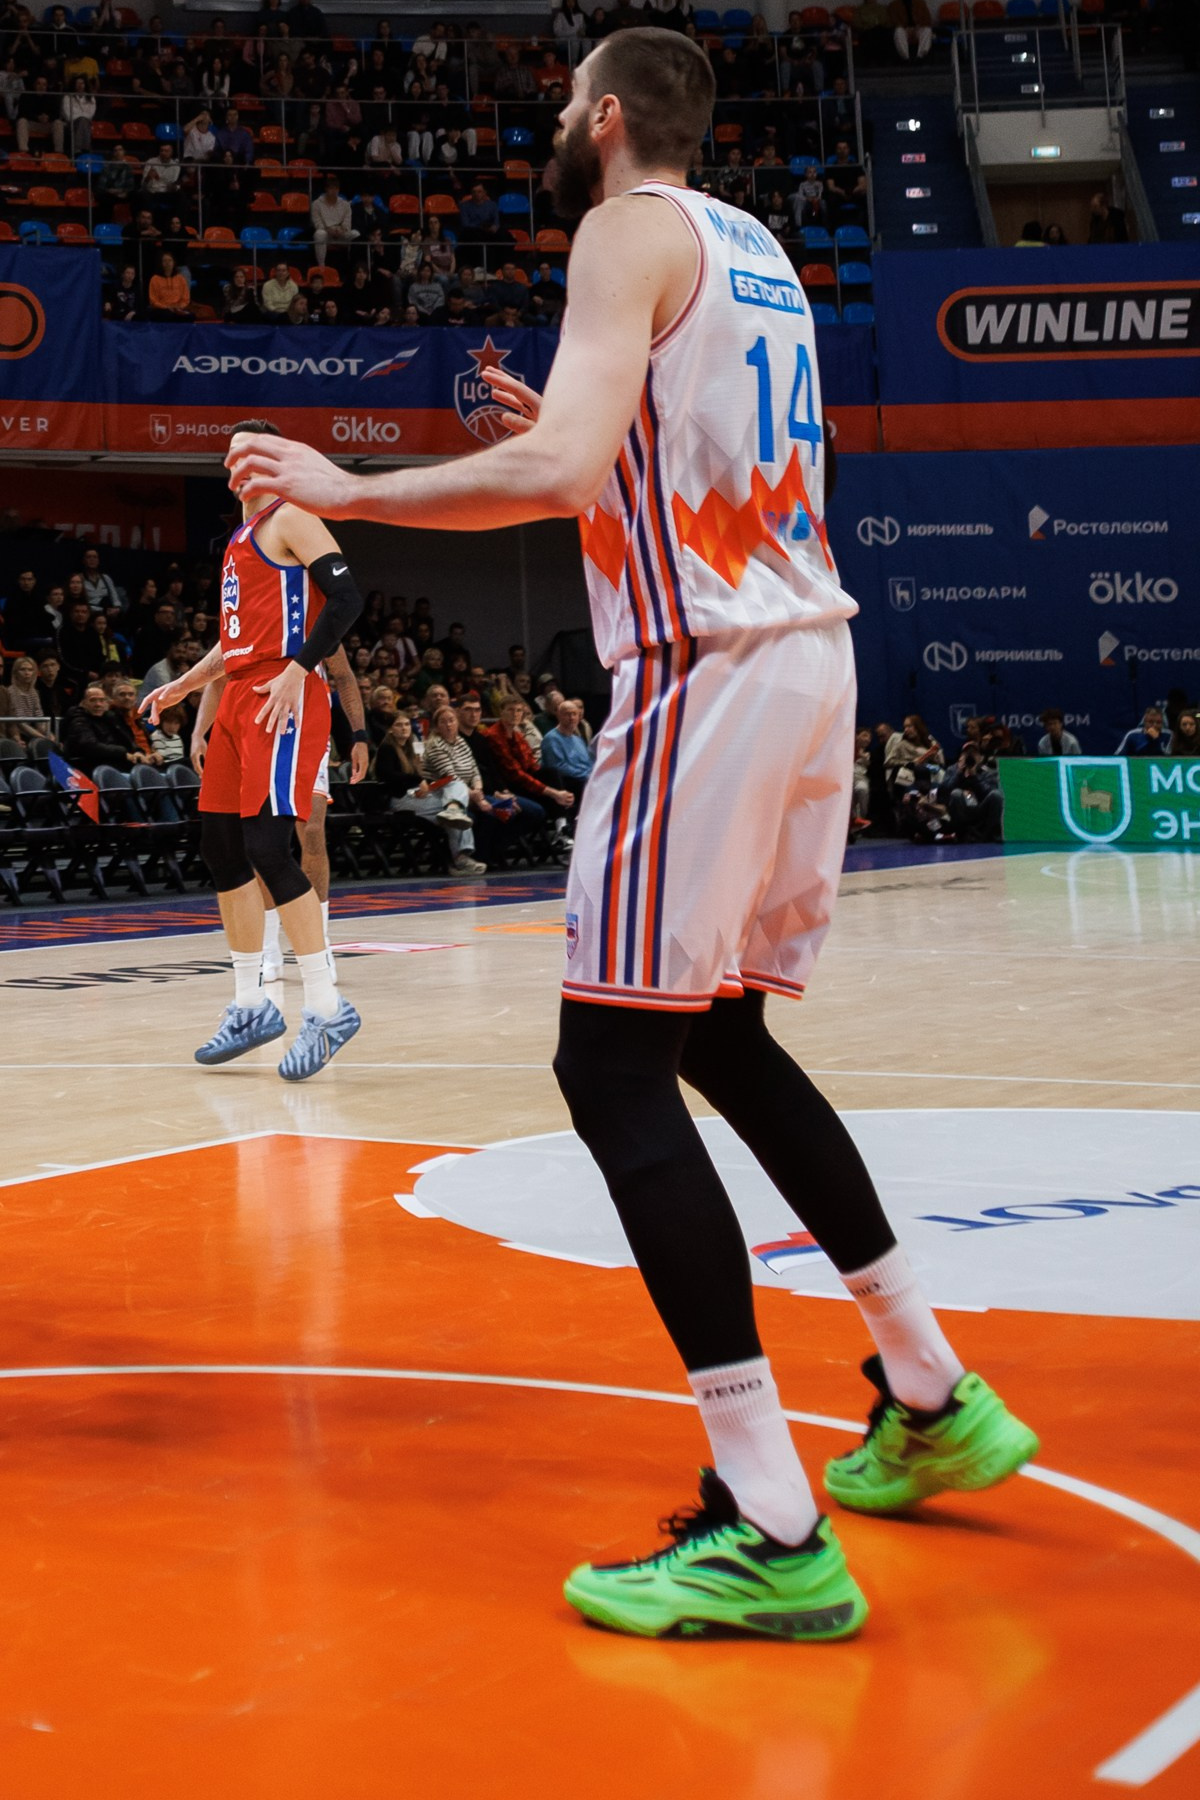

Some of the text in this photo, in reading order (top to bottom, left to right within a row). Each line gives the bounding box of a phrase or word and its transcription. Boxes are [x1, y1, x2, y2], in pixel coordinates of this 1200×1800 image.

[966, 298, 1192, 345] WINLINE
[172, 355, 364, 376] АЭРОФЛОТ
[746, 336, 822, 467] 14
[907, 523, 994, 537] НОРНИКЕЛЬ
[1053, 518, 1170, 536] Ростелеком
[921, 585, 1027, 602] ЭНДОФАРМ
